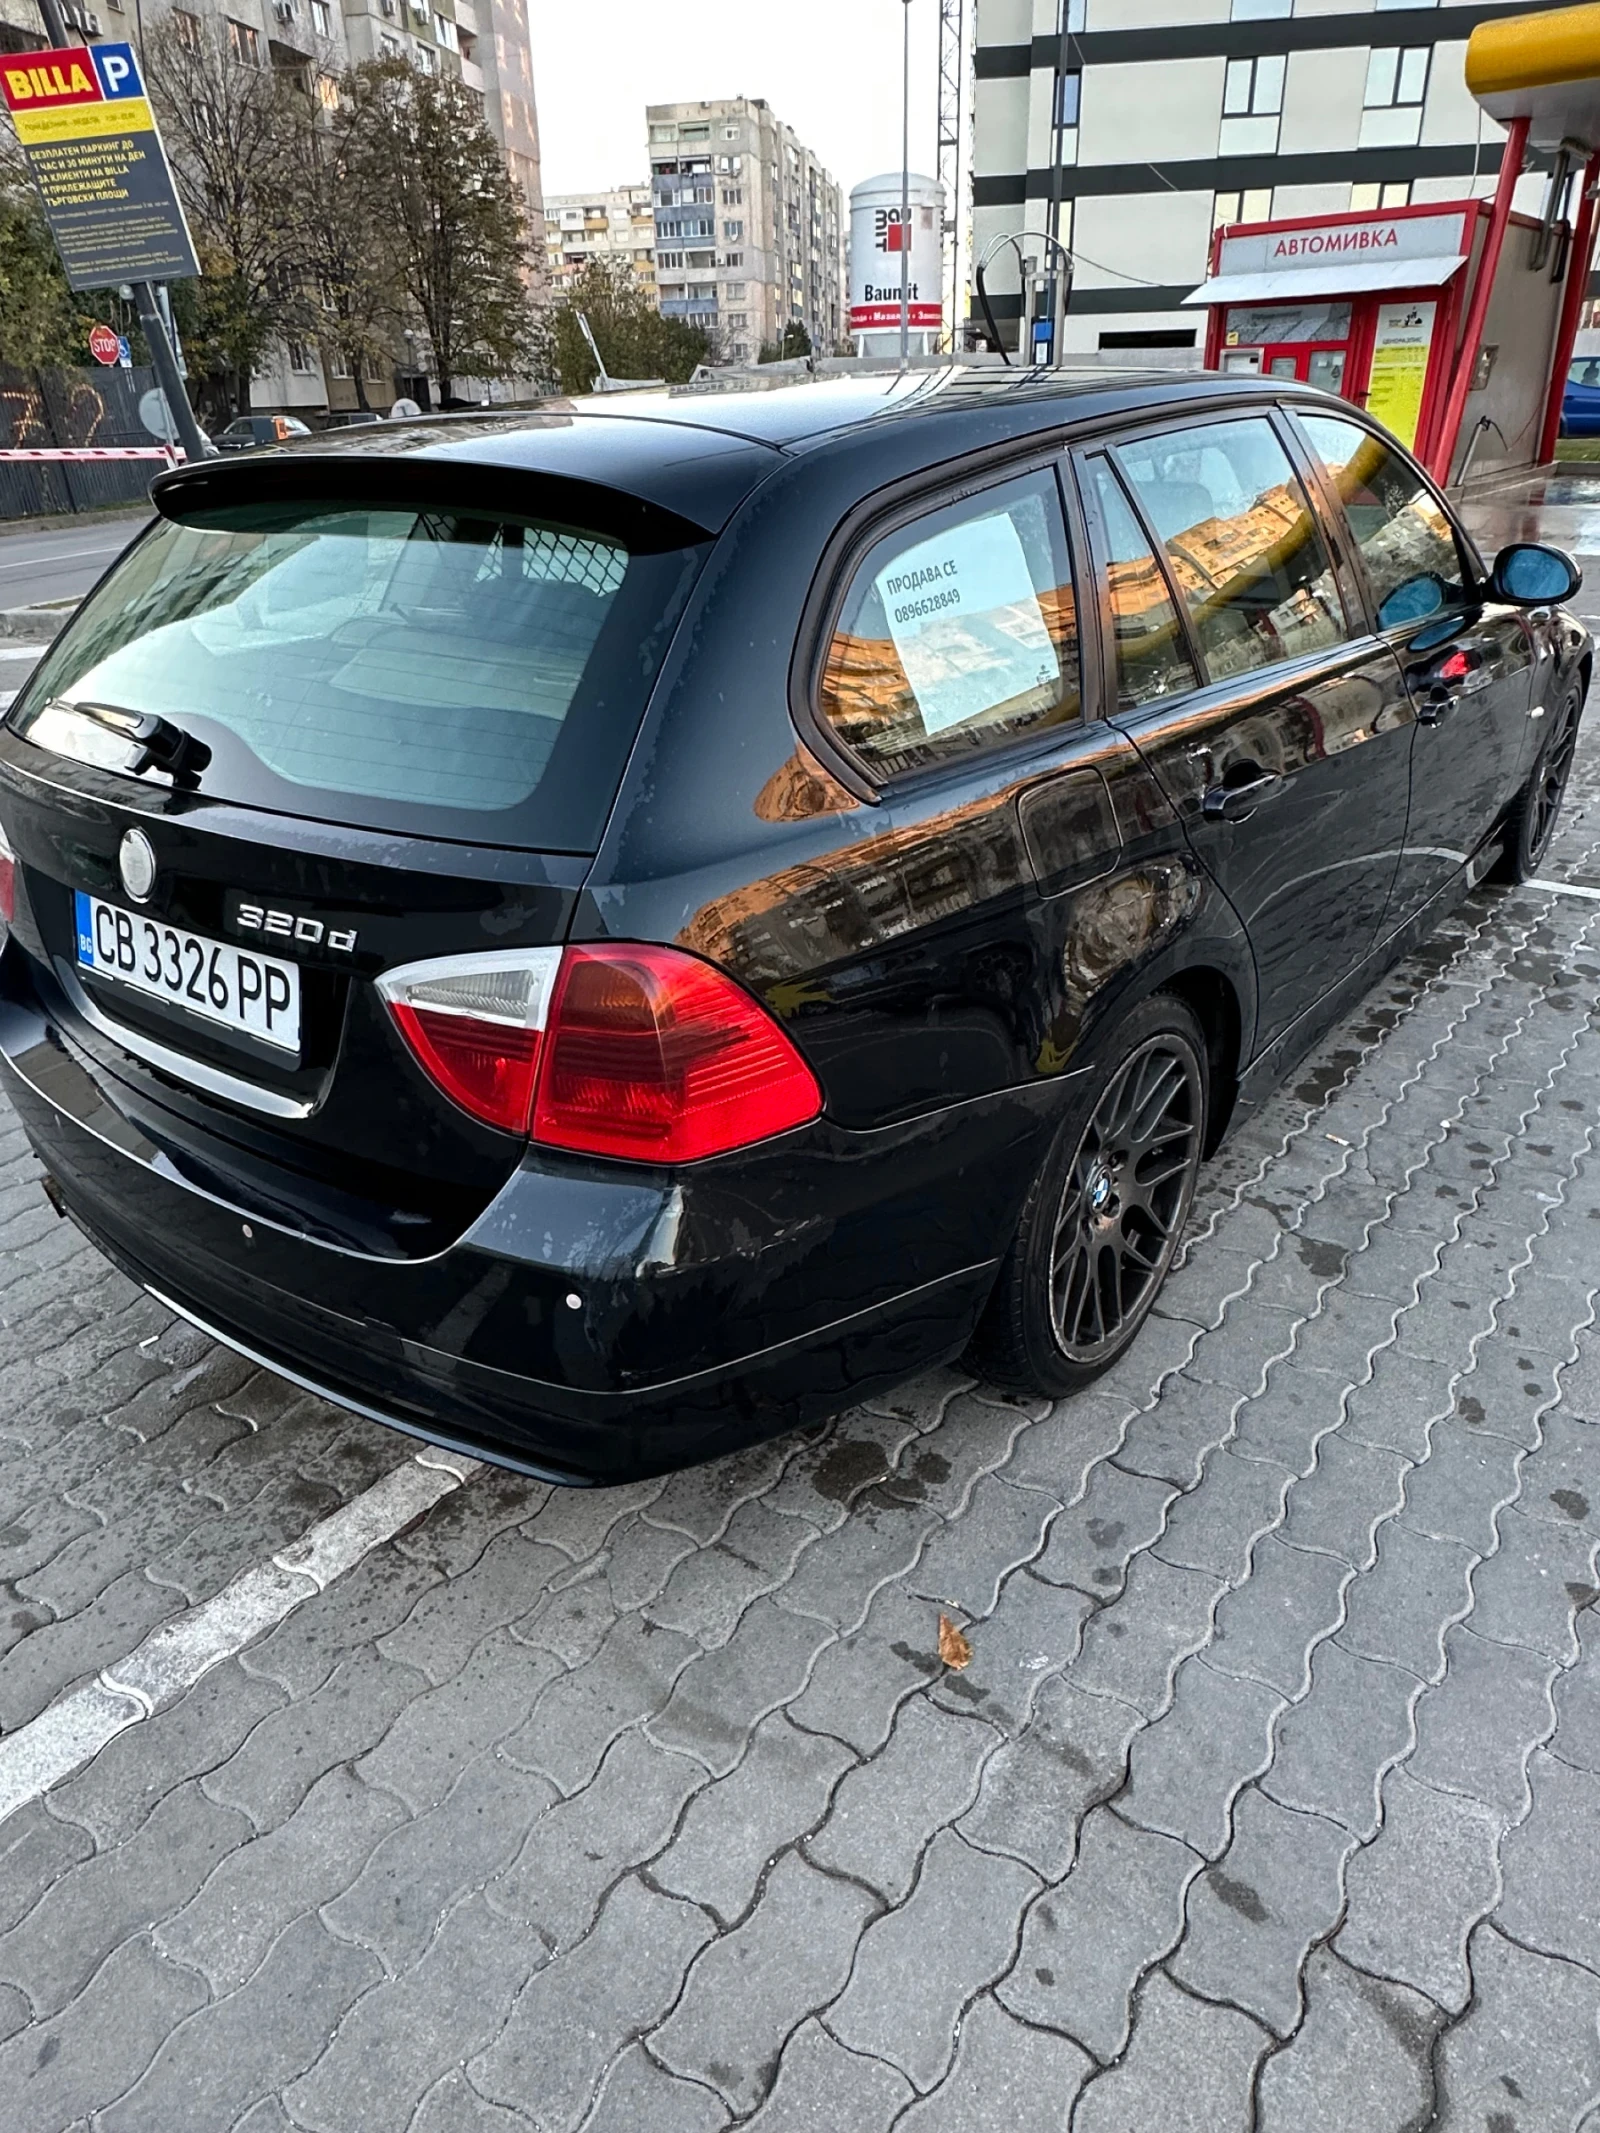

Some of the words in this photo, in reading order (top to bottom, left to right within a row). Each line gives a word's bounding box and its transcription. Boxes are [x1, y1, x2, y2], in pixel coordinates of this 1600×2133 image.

[4, 64, 94, 99] BILLA
[102, 56, 129, 92] P
[30, 146, 79, 160] БЕЗПЛАТЕН
[80, 140, 119, 154] ПАРКИНГ
[121, 139, 134, 150] ДО
[40, 161, 58, 171] ЧАС
[59, 160, 65, 169] И
[67, 159, 77, 168] 30
[78, 155, 114, 167] МИНУТИ
[115, 153, 127, 162] НА
[127, 150, 146, 162] ДЕН
[37, 174, 50, 184] ЗА
[50, 169, 90, 182] КЛИЕНТИ
[91, 168, 104, 177] НА
[104, 164, 129, 176] BILLA
[41, 186, 49, 195] И
[49, 178, 117, 195] ПРИЛЕЖАЩИТЕ
[45, 193, 95, 207] ТЪРГОВСКИ
[95, 188, 129, 201] ПЛОЩИ
[1274, 228, 1398, 257] АВТОМИВКА
[94, 339, 116, 353] STOP
[887, 567, 942, 595] ПРОДАВА
[943, 560, 957, 577] СЕ
[895, 588, 961, 624] 0896628849
[237, 904, 358, 952] 320d
[80, 934, 92, 954] BG
